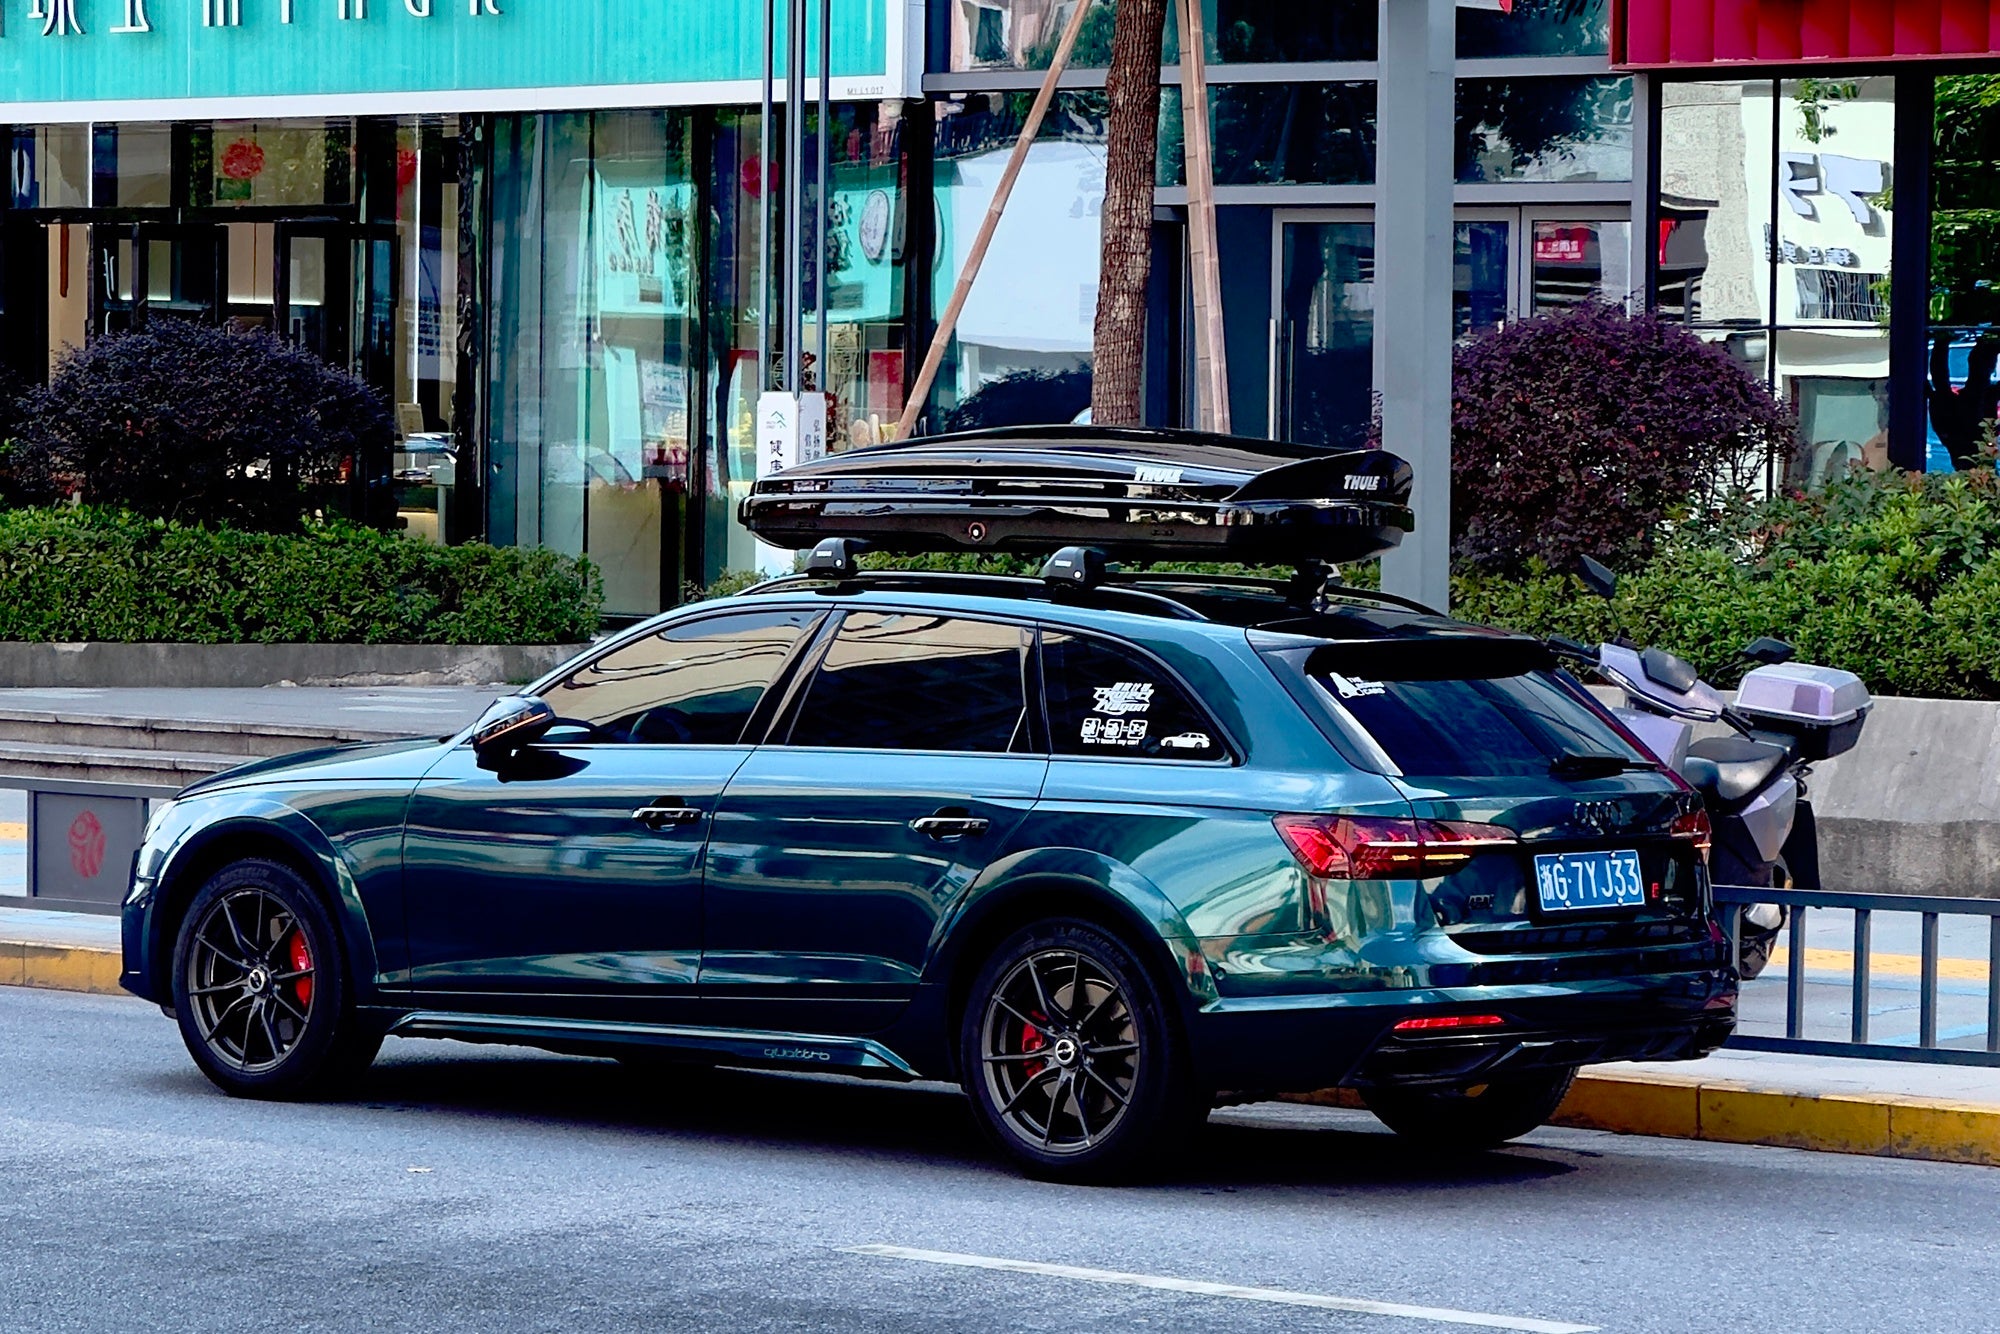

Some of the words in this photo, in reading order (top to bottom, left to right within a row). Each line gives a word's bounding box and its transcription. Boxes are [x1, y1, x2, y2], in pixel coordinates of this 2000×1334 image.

[1134, 466, 1184, 482] THULE
[1344, 475, 1380, 490] THULE
[764, 1047, 831, 1061] quattro
